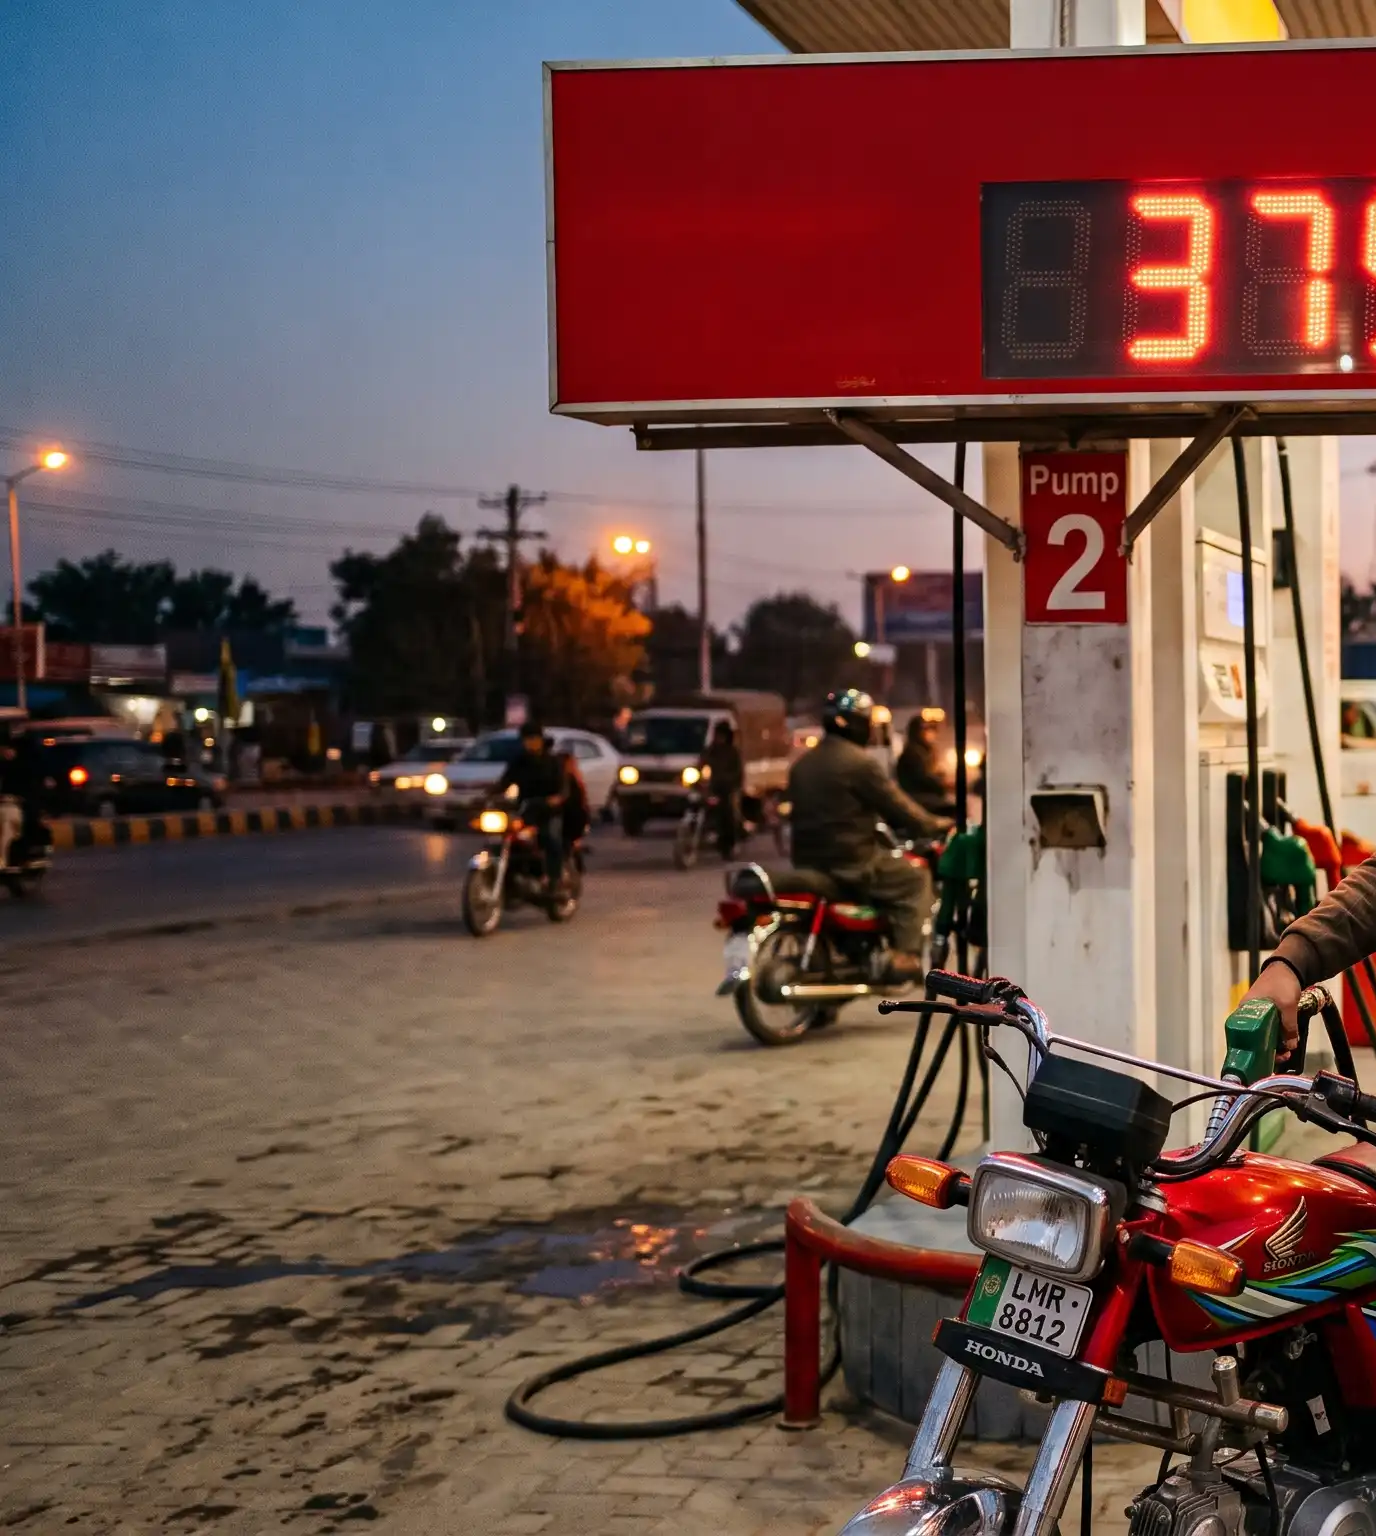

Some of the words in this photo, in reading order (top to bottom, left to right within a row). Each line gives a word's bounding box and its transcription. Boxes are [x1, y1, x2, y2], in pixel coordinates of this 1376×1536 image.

[1030, 464, 1119, 502] Pump
[1046, 513, 1106, 610] 2
[1011, 1272, 1066, 1313] LMR
[998, 1303, 1066, 1347] 8812
[964, 1339, 1044, 1377] HONDA
